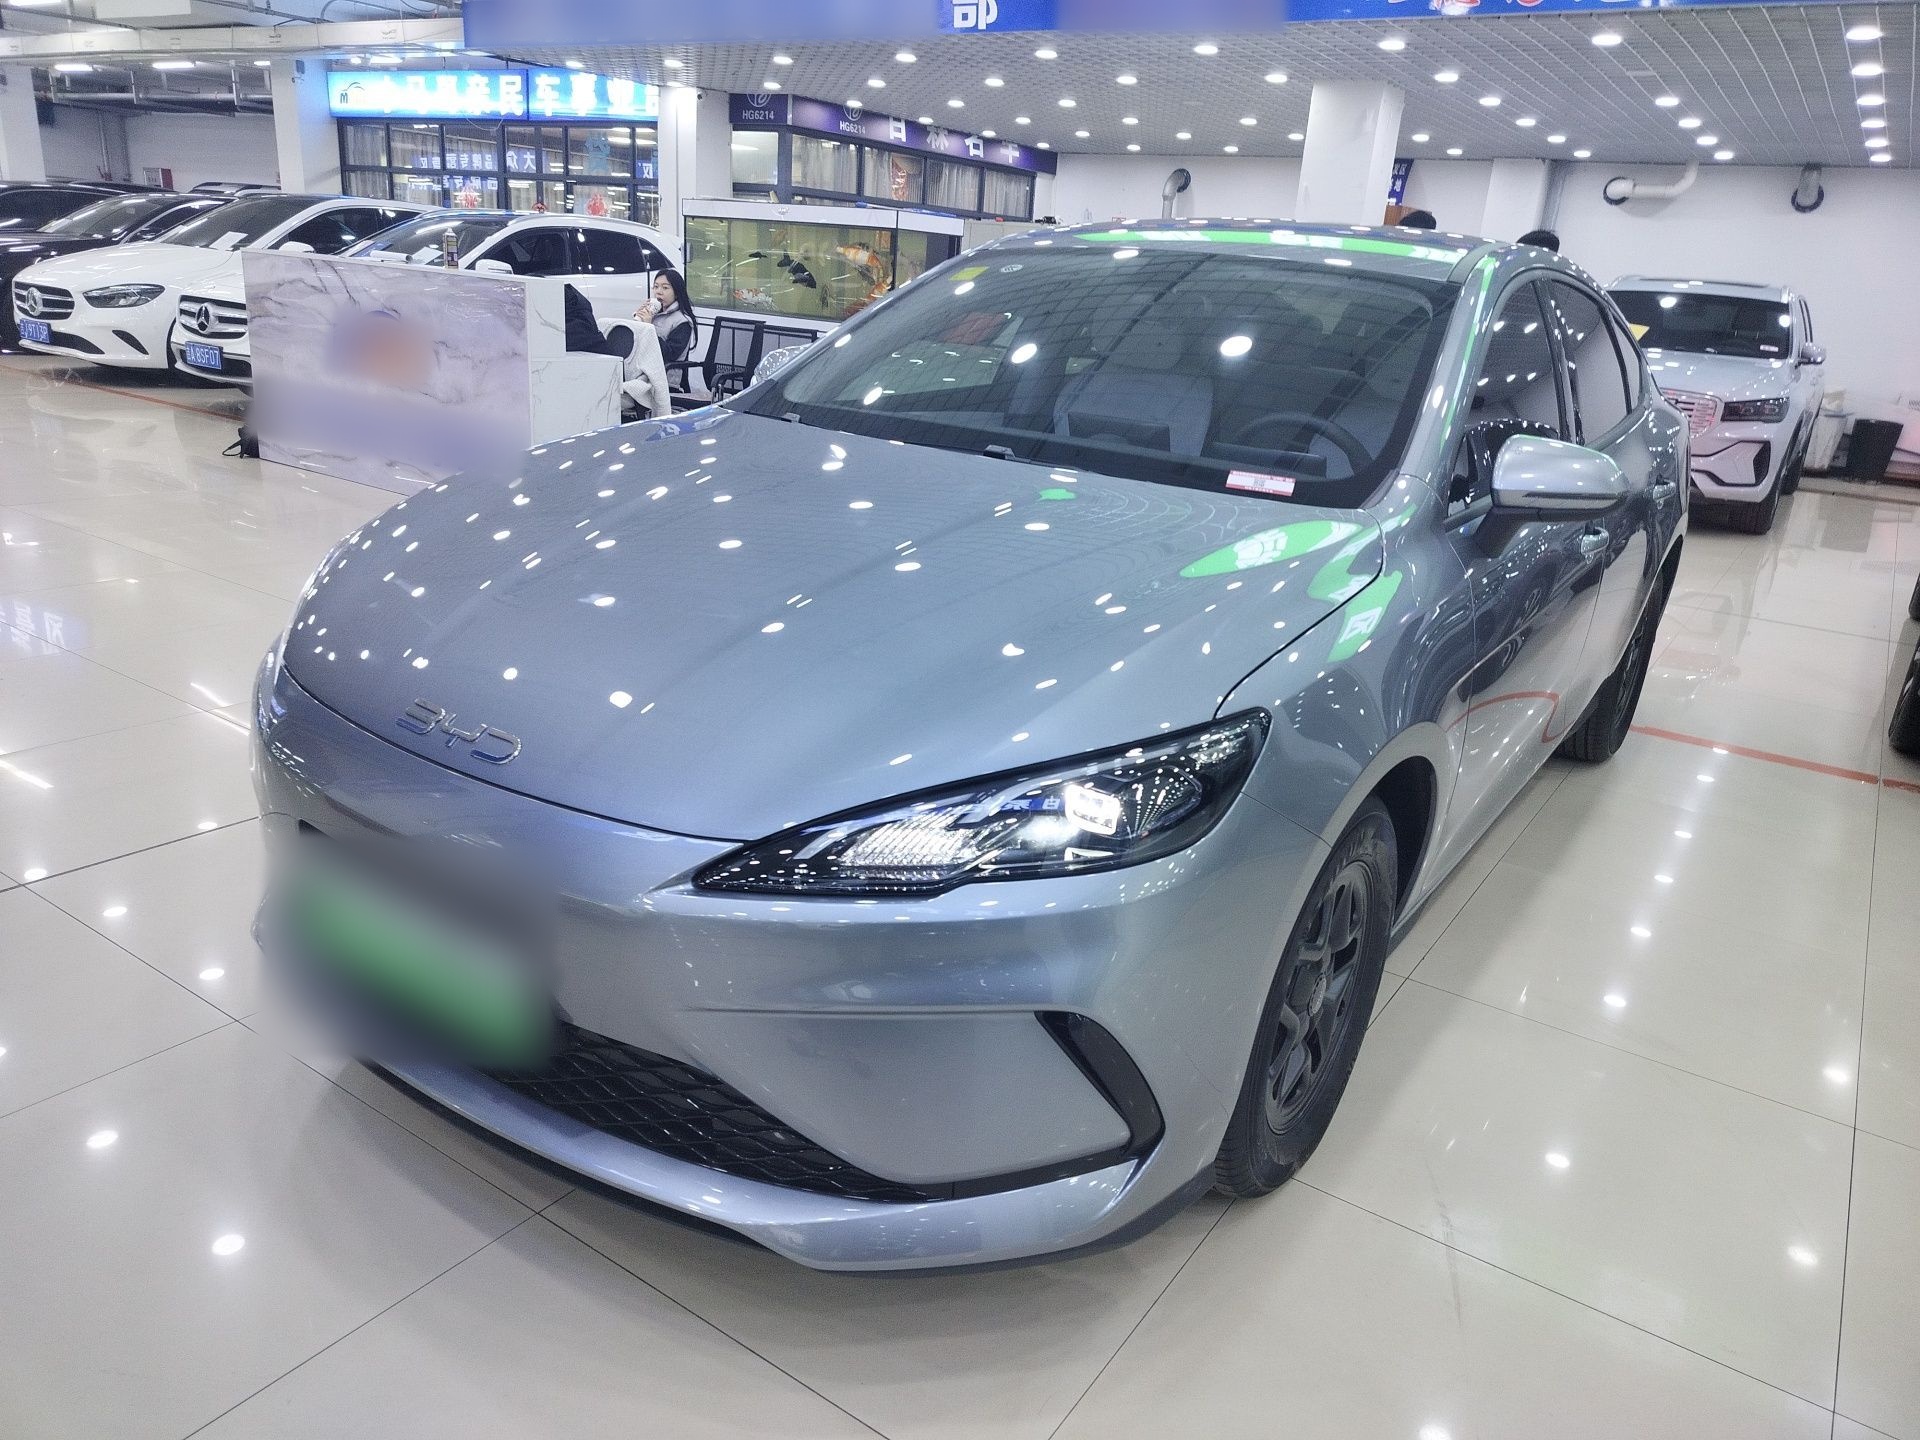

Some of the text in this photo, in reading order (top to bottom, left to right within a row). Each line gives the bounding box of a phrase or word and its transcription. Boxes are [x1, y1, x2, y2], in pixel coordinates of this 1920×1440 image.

[742, 110, 774, 120] HG6214
[840, 121, 866, 134] HG6214
[396, 698, 522, 765] BYD
